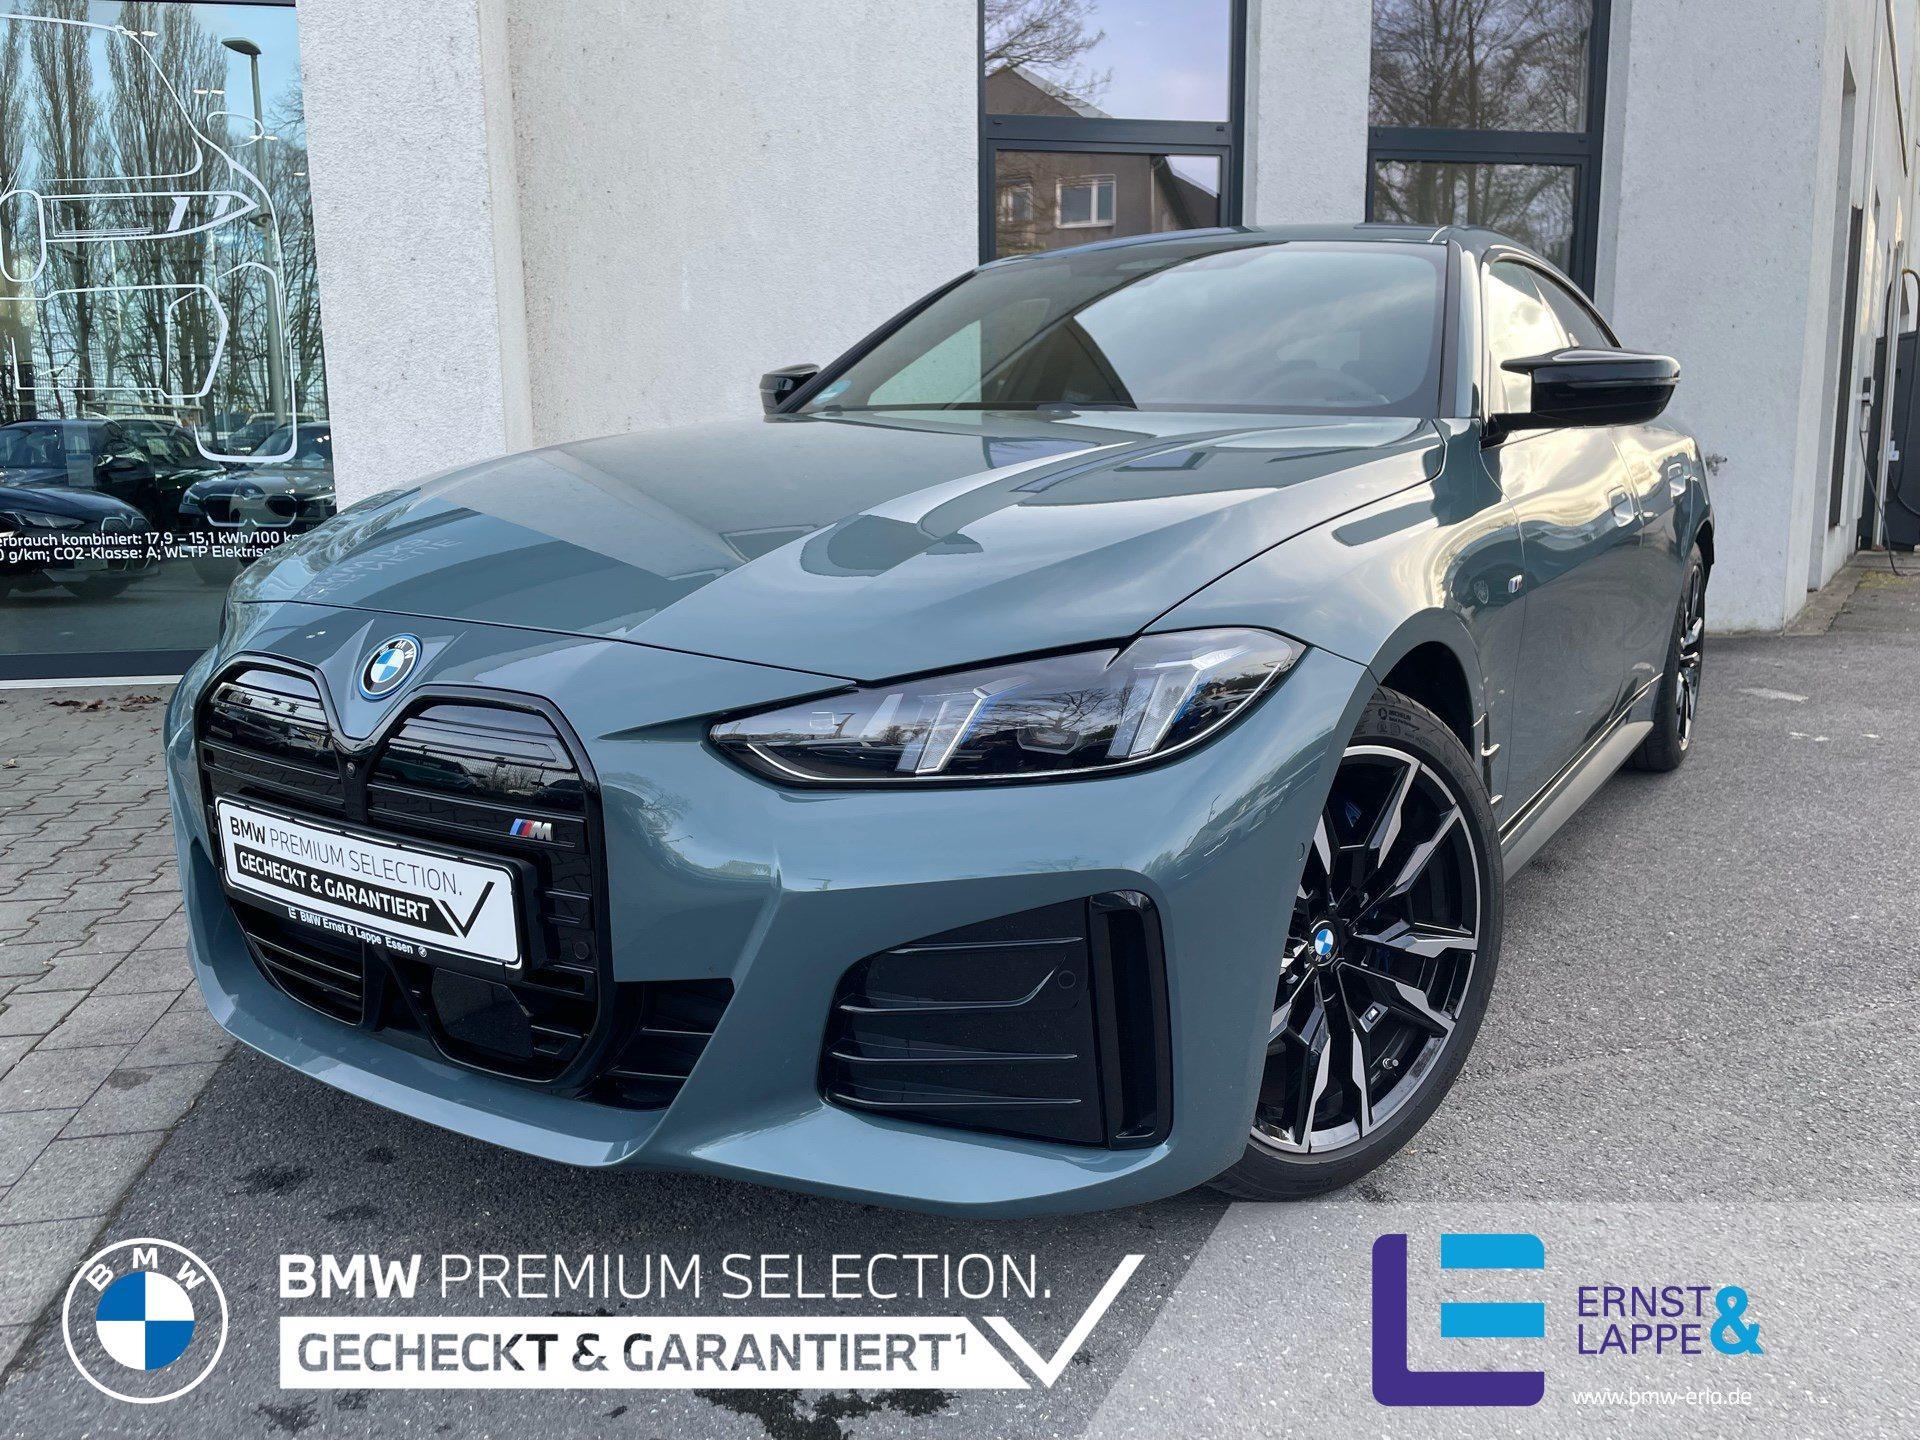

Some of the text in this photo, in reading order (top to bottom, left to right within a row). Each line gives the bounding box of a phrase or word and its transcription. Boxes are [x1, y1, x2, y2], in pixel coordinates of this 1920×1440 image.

[0, 533, 58, 547] rbrauch
[61, 533, 142, 546] kombiniert:
[145, 531, 173, 547] 17,9
[188, 531, 214, 546] 15,1
[218, 531, 280, 544] kWh/100
[8, 548, 50, 563] g/km;
[53, 546, 142, 560] CO2-Klasse:
[146, 546, 162, 561] A;
[164, 545, 208, 558] WLTP
[230, 816, 463, 896] BMW PREMIUM SELECTION.
[239, 851, 430, 922] GECHECKT & GARANTIERT
[300, 911, 322, 927] BMW
[323, 917, 346, 934] Ernst
[347, 925, 354, 937] &
[355, 927, 382, 945] Lappe
[385, 936, 414, 955] Essen
